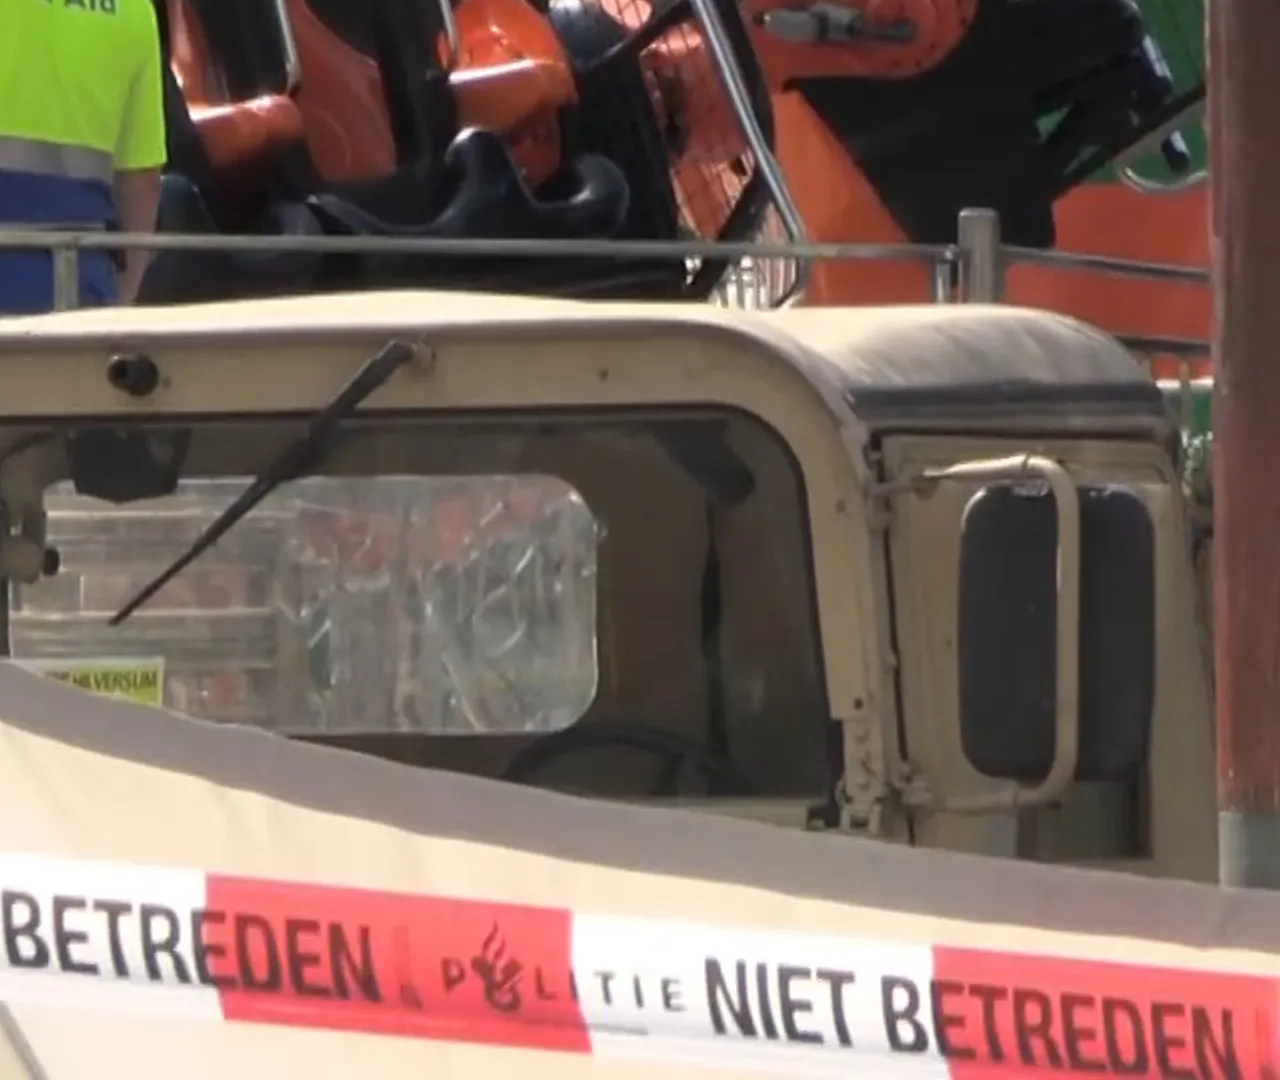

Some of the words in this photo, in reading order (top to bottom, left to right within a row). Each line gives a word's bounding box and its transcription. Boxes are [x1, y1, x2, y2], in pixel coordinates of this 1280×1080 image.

[0, 889, 384, 1004] BETREDEN
[704, 957, 858, 1049] NIET
[880, 974, 1245, 1080] BETREDEN
